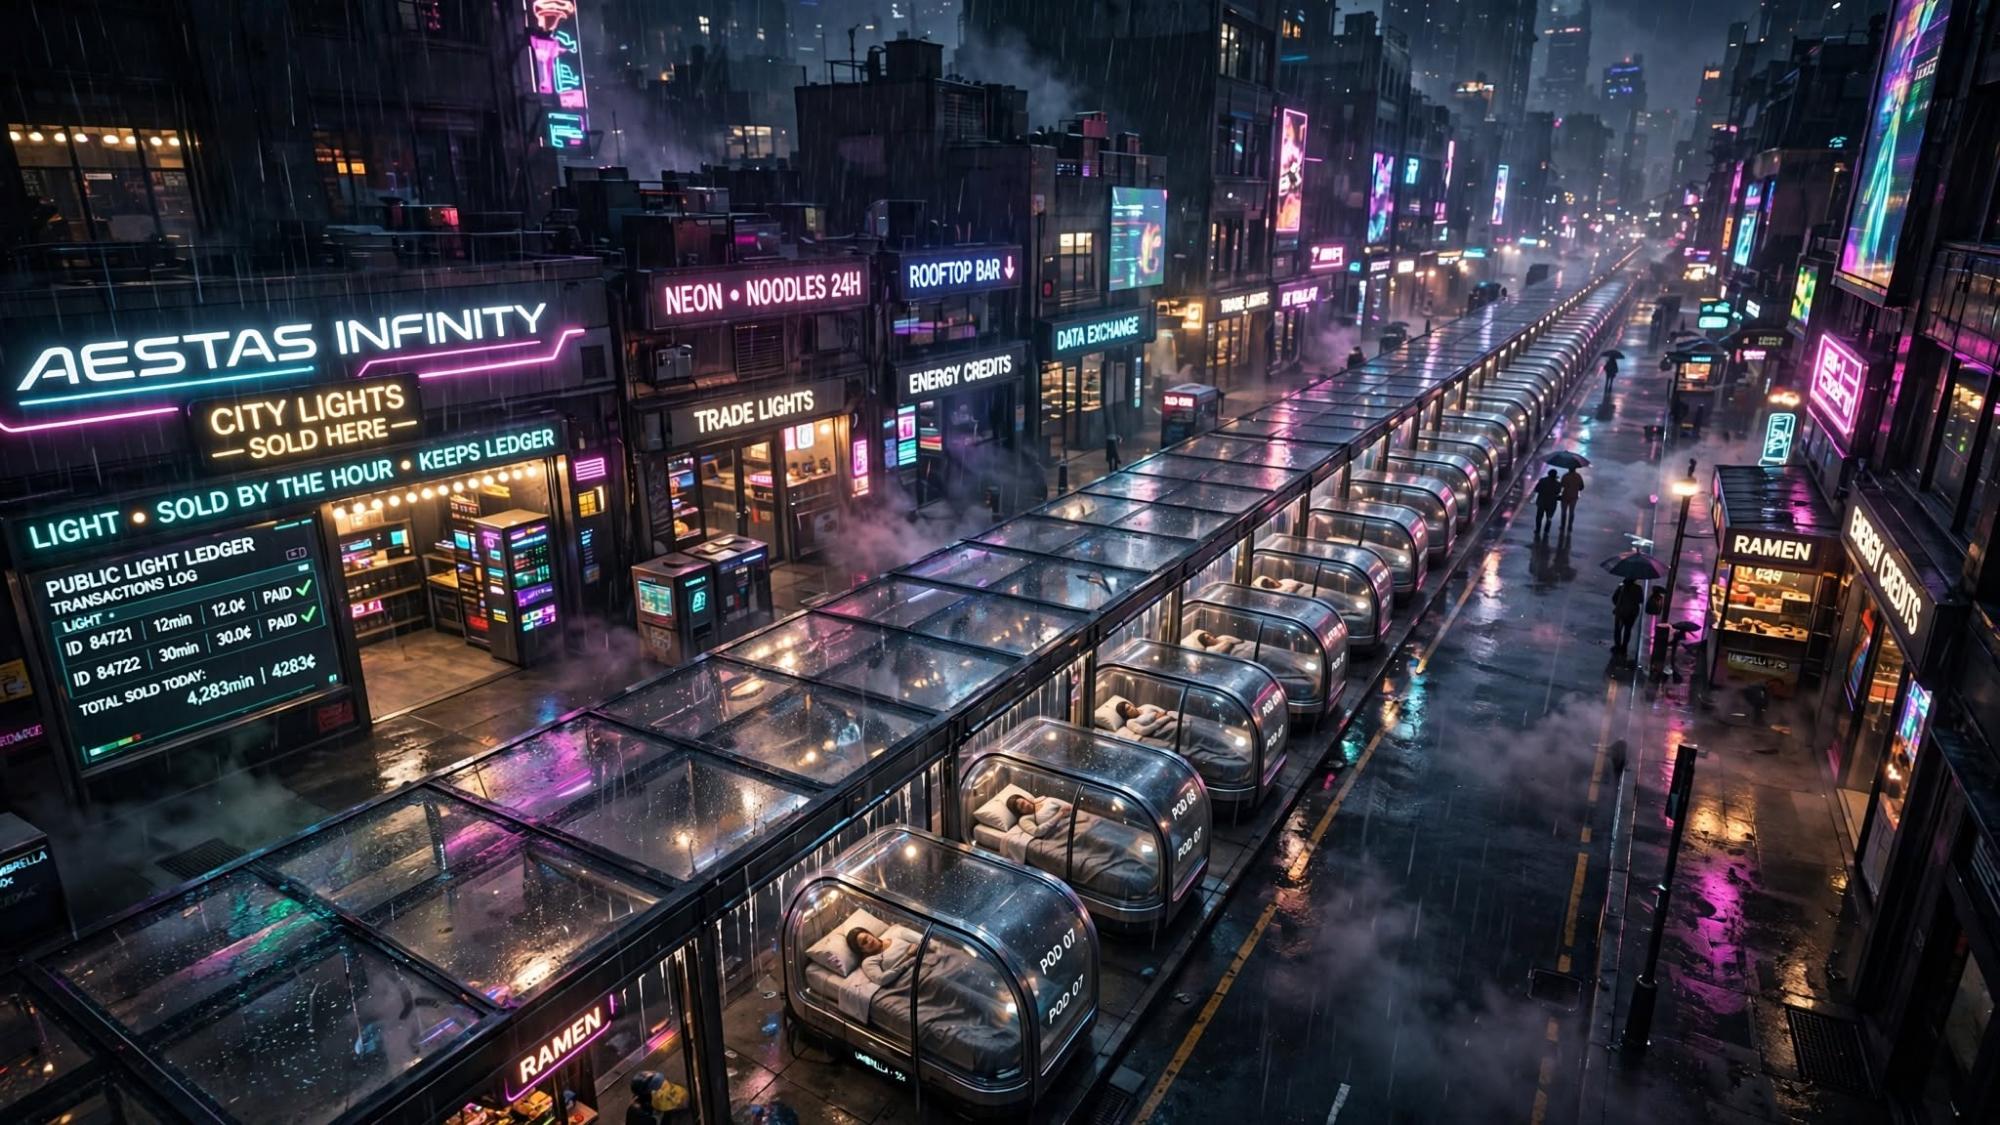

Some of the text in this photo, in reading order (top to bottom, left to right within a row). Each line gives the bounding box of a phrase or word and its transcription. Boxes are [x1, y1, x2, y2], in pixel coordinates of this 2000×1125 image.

[665, 271, 861, 315] NEON NOODLES 24H
[909, 258, 1001, 288] ROOFTOP BAR
[17, 302, 547, 391] AESTAS INFINITY
[1057, 316, 1139, 350] DATA EXCHANGE
[909, 354, 1012, 394] ENERGY CREDITS
[210, 384, 405, 436] CITY LIGHTS
[693, 390, 815, 433] TRADE LIGHTS
[249, 417, 389, 459] SOLD HERE
[29, 428, 555, 549] LIGHT SOLD BY THE HOUR KEEPS LEDGER
[45, 537, 255, 597] PUBLIC LIGHT LEDGER
[1733, 534, 1812, 561] RAMEN
[51, 570, 198, 616] TRANSACTIONS LOG
[1879, 551, 1922, 635] CREDITS
[62, 613, 102, 633] LIGHT
[65, 586, 292, 657] ID 84721 12min 12.0¢ PAID
[73, 612, 298, 688] ID 84722 30min 30.0¢ PAID
[79, 669, 207, 717] TOTAL SOLD TODAY:
[186, 653, 316, 707] 4,283min 4283¢
[1172, 799, 1187, 821] POD
[1178, 837, 1193, 861] POD
[1040, 927, 1076, 975] POD 07
[1048, 974, 1084, 1024] POD 07
[519, 1006, 601, 1084] RAMEN
